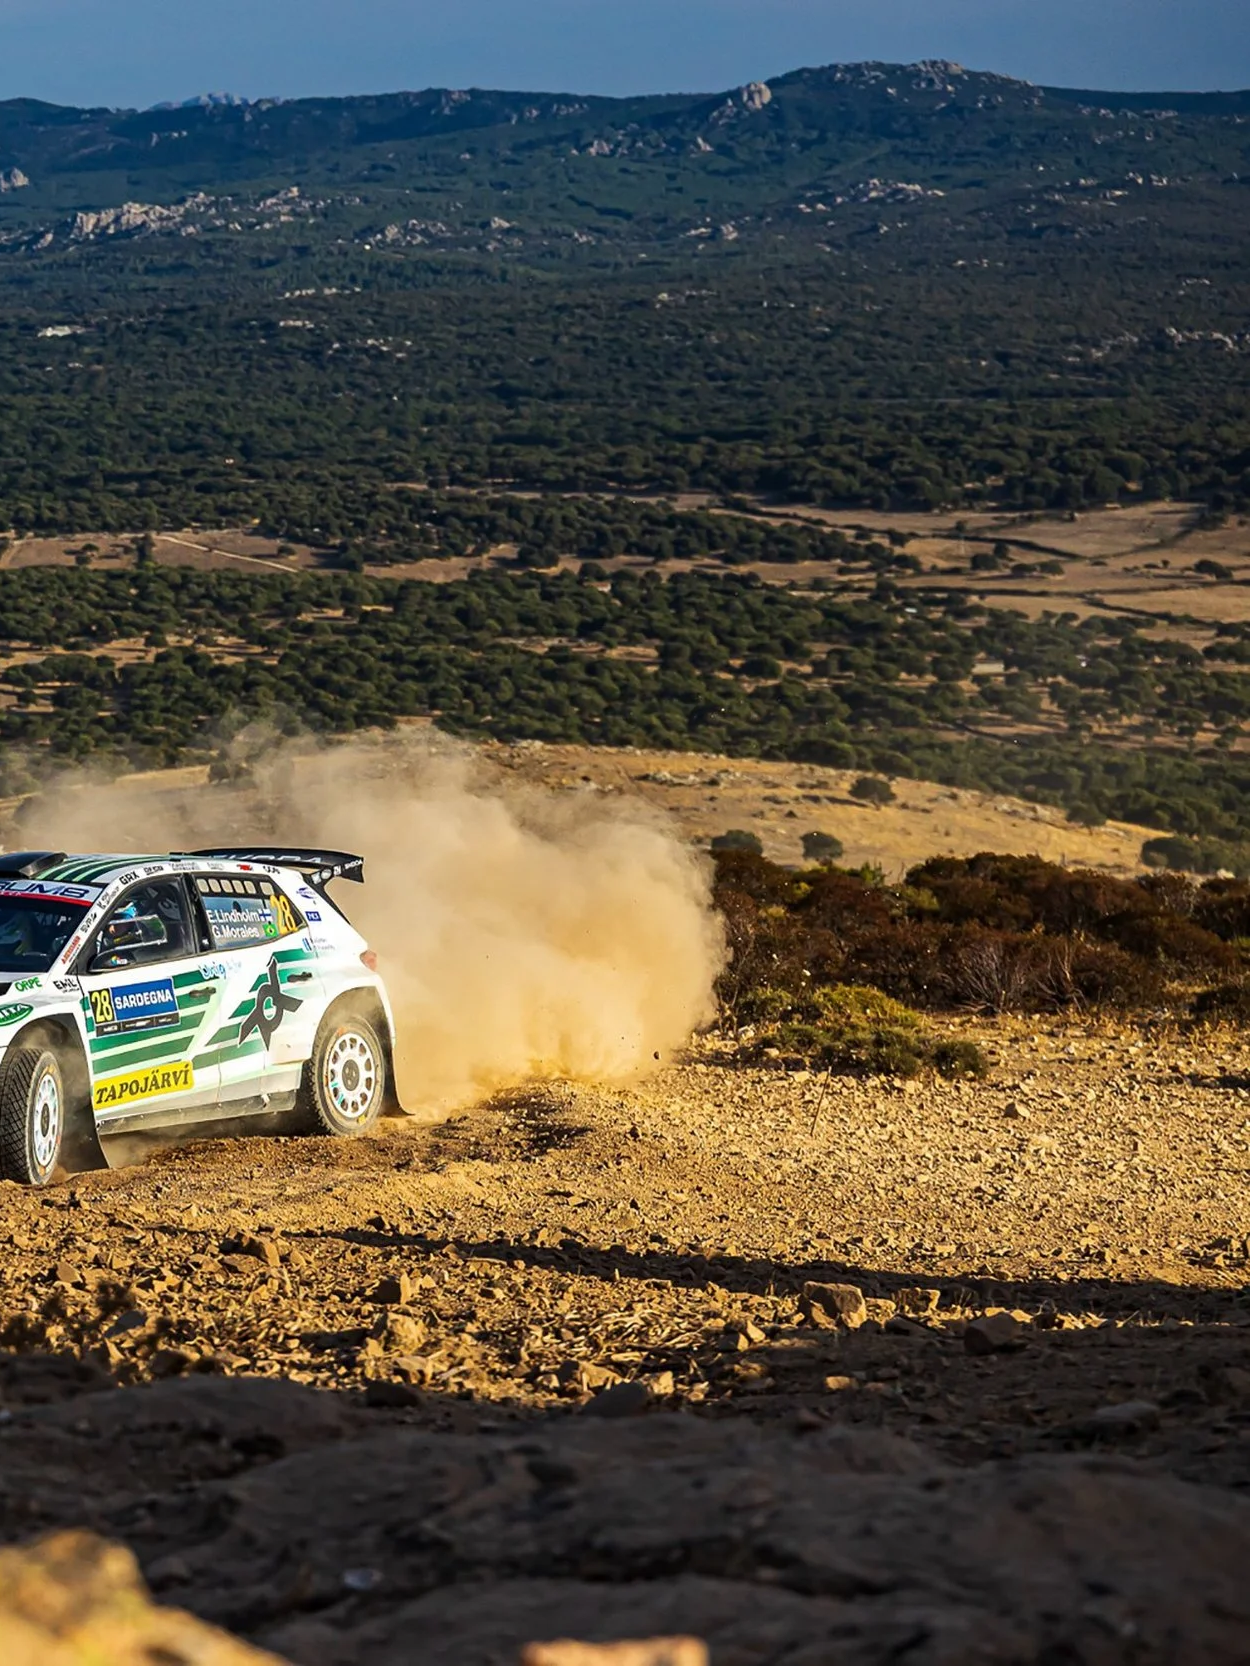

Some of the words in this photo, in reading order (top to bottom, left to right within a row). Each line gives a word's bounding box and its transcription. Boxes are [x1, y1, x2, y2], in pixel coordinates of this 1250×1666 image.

[118, 871, 140, 885] GRX
[206, 908, 260, 923] E.Lindholm
[270, 894, 297, 935] 28
[212, 924, 260, 939] G.Morales
[14, 977, 43, 992] ORPE
[91, 990, 113, 1022] 28
[115, 988, 173, 1010] SARDEGNA
